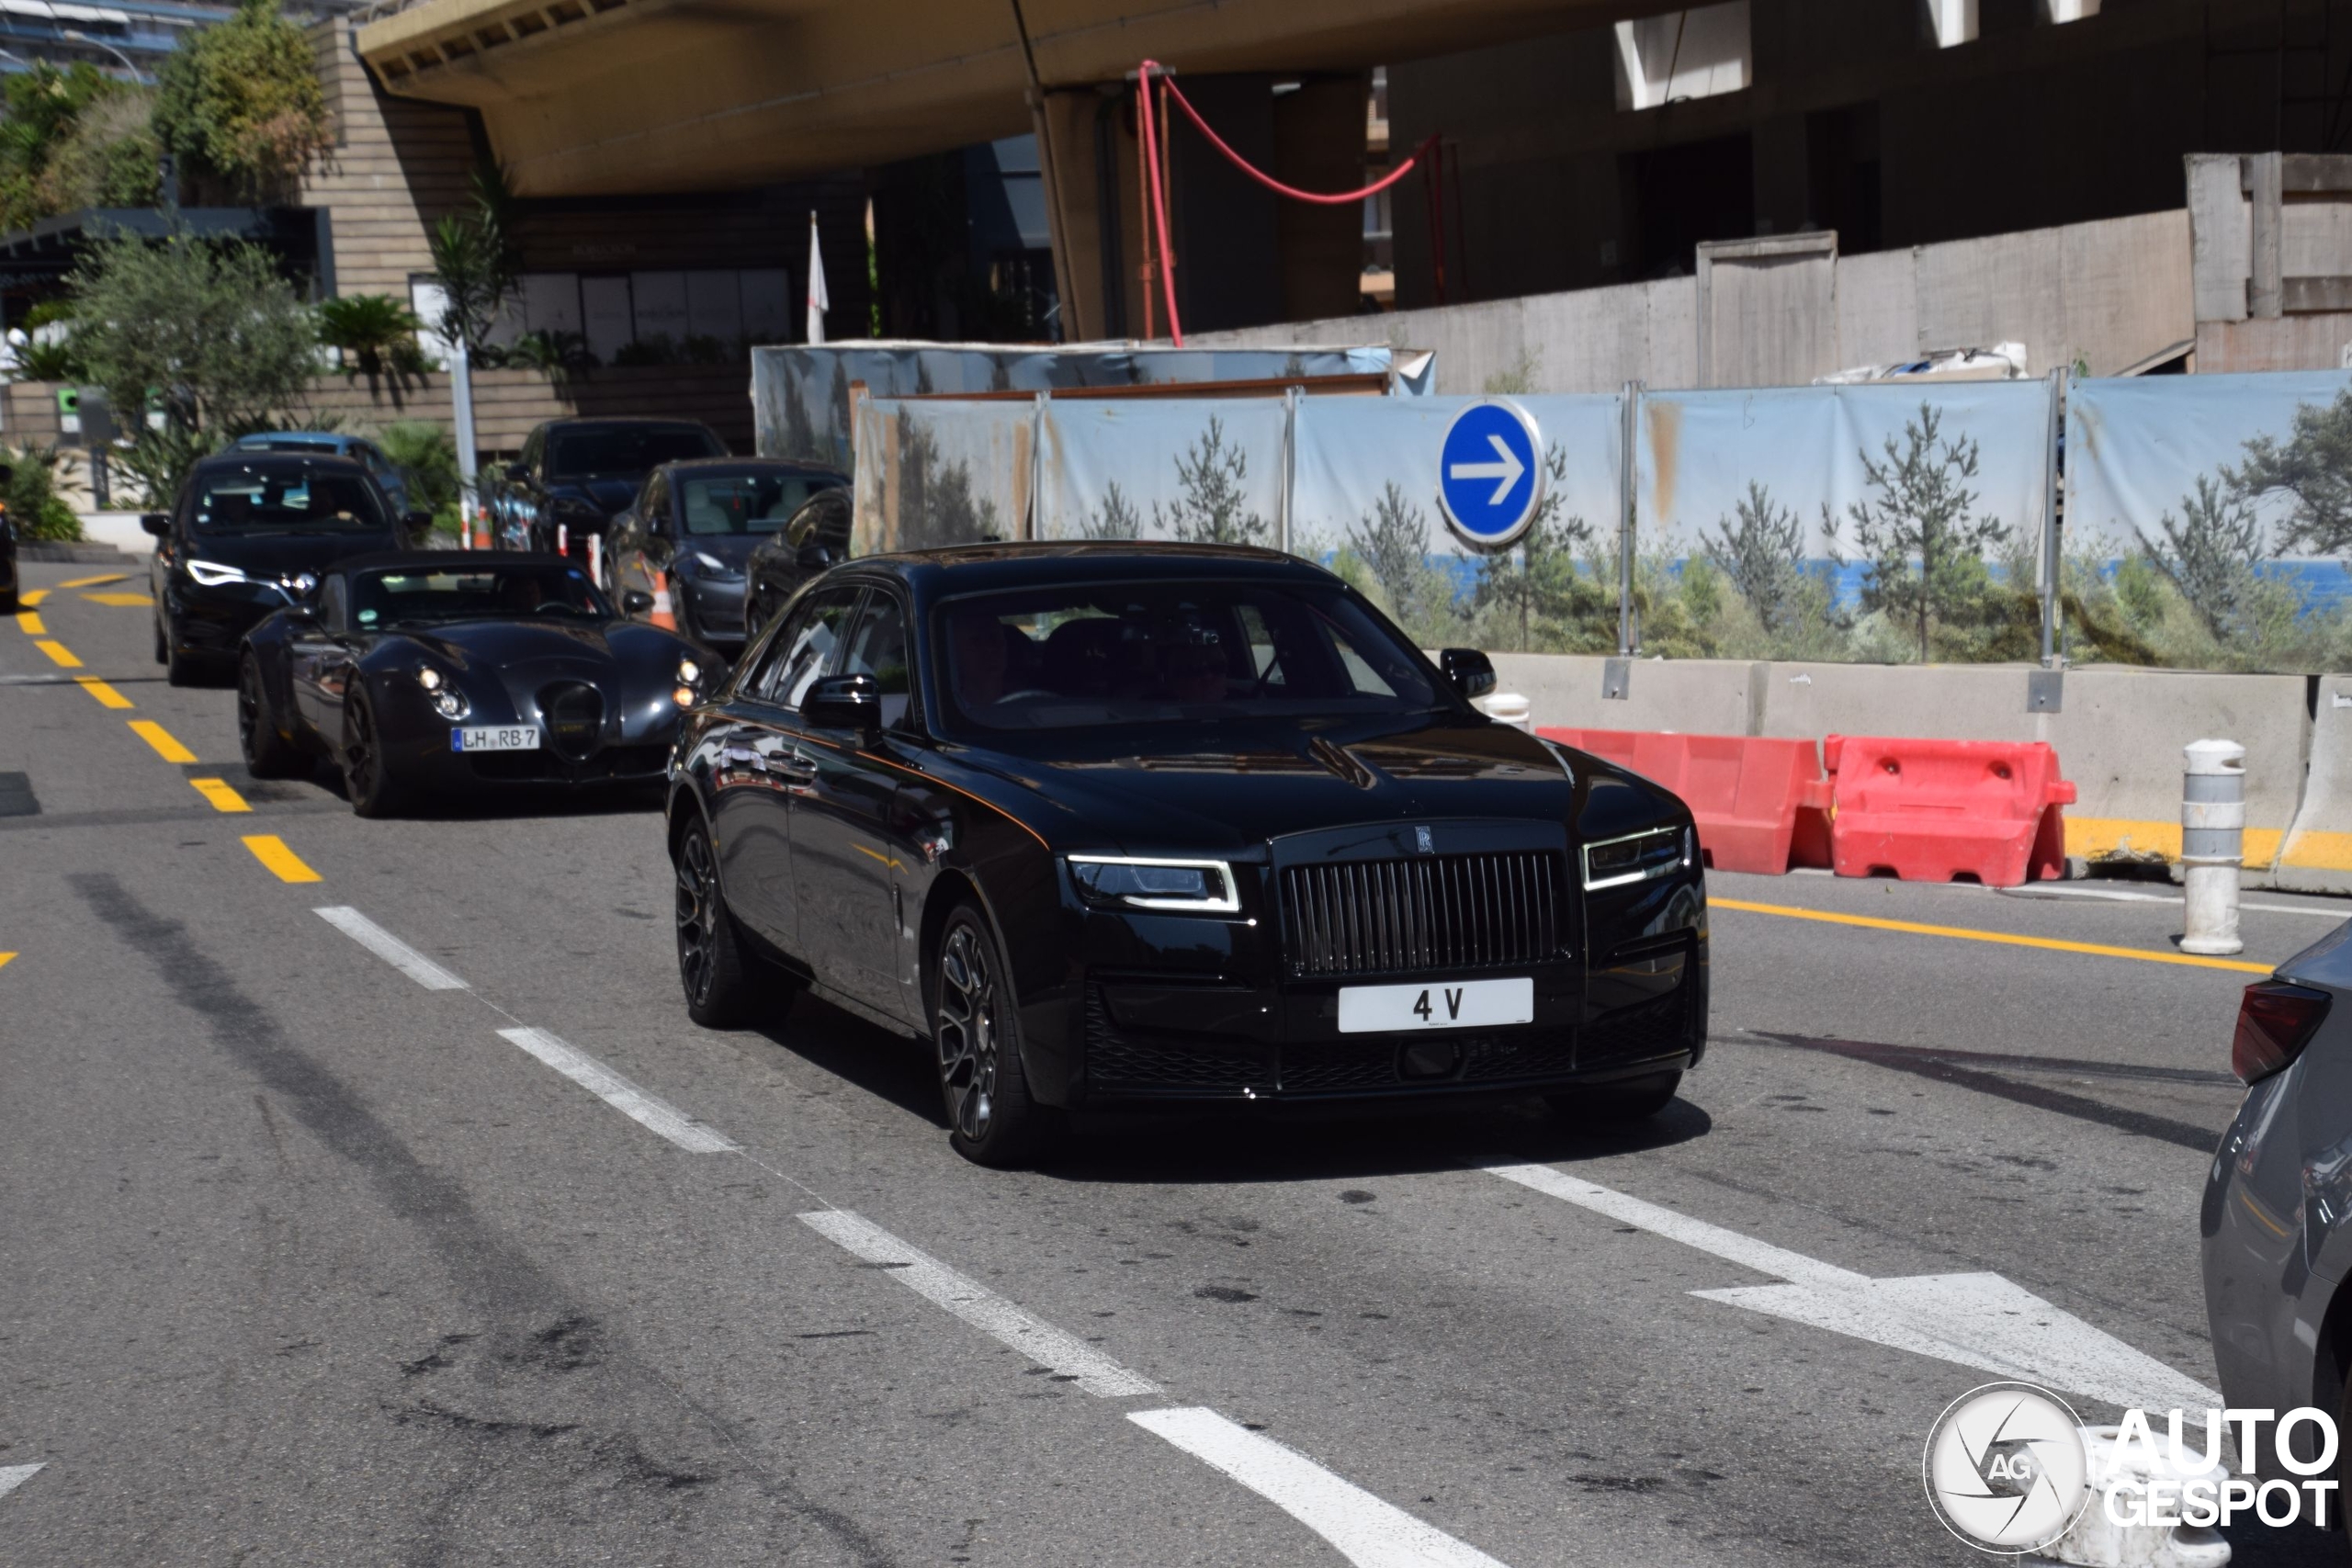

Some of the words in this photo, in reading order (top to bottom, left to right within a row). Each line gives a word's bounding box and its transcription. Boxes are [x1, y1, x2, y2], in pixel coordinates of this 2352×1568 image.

[463, 731, 486, 748] LH
[499, 730, 522, 747] RB
[526, 729, 536, 746] 7
[1413, 989, 1432, 1021] 4
[1444, 987, 1464, 1021] V
